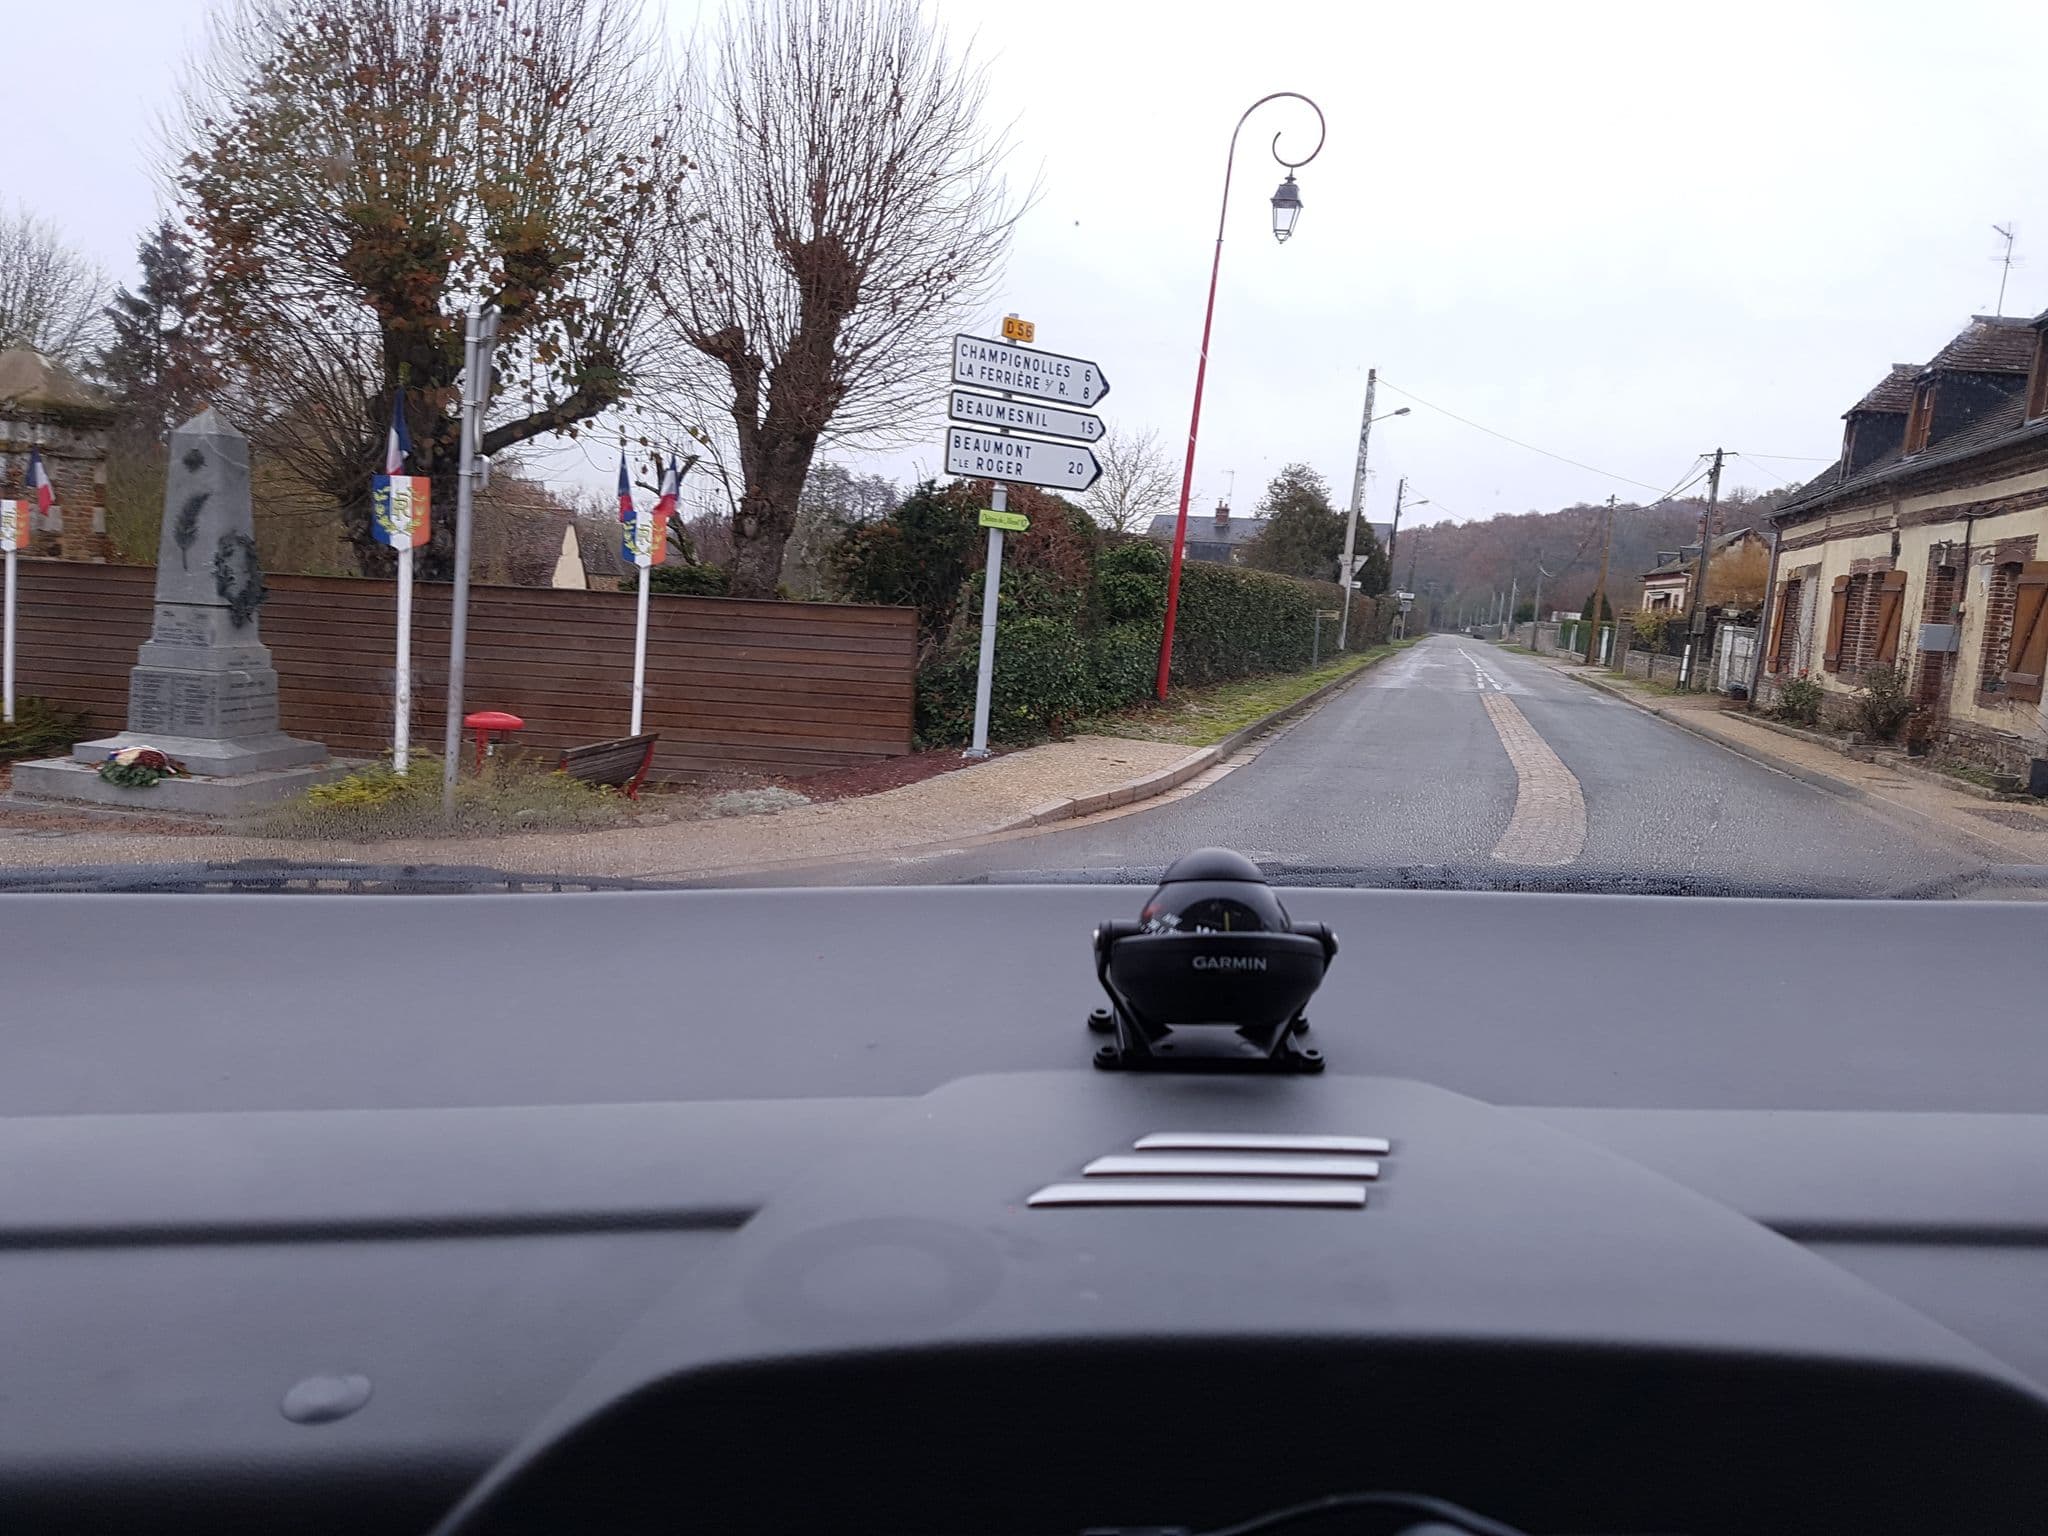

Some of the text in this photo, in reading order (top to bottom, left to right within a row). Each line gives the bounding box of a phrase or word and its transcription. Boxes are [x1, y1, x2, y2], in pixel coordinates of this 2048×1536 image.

[961, 343, 1091, 382] CHAMPIGNOLLES 6
[959, 362, 974, 377] LA
[980, 366, 1040, 390] FERRIÈRE
[1083, 387, 1090, 399] 8
[956, 399, 1094, 434] BEAUMESNIL 15
[954, 435, 1032, 459] BEAUMONT
[976, 457, 1023, 476] ROGER
[1068, 461, 1084, 475] 20
[1192, 955, 1267, 972] GARMIN
